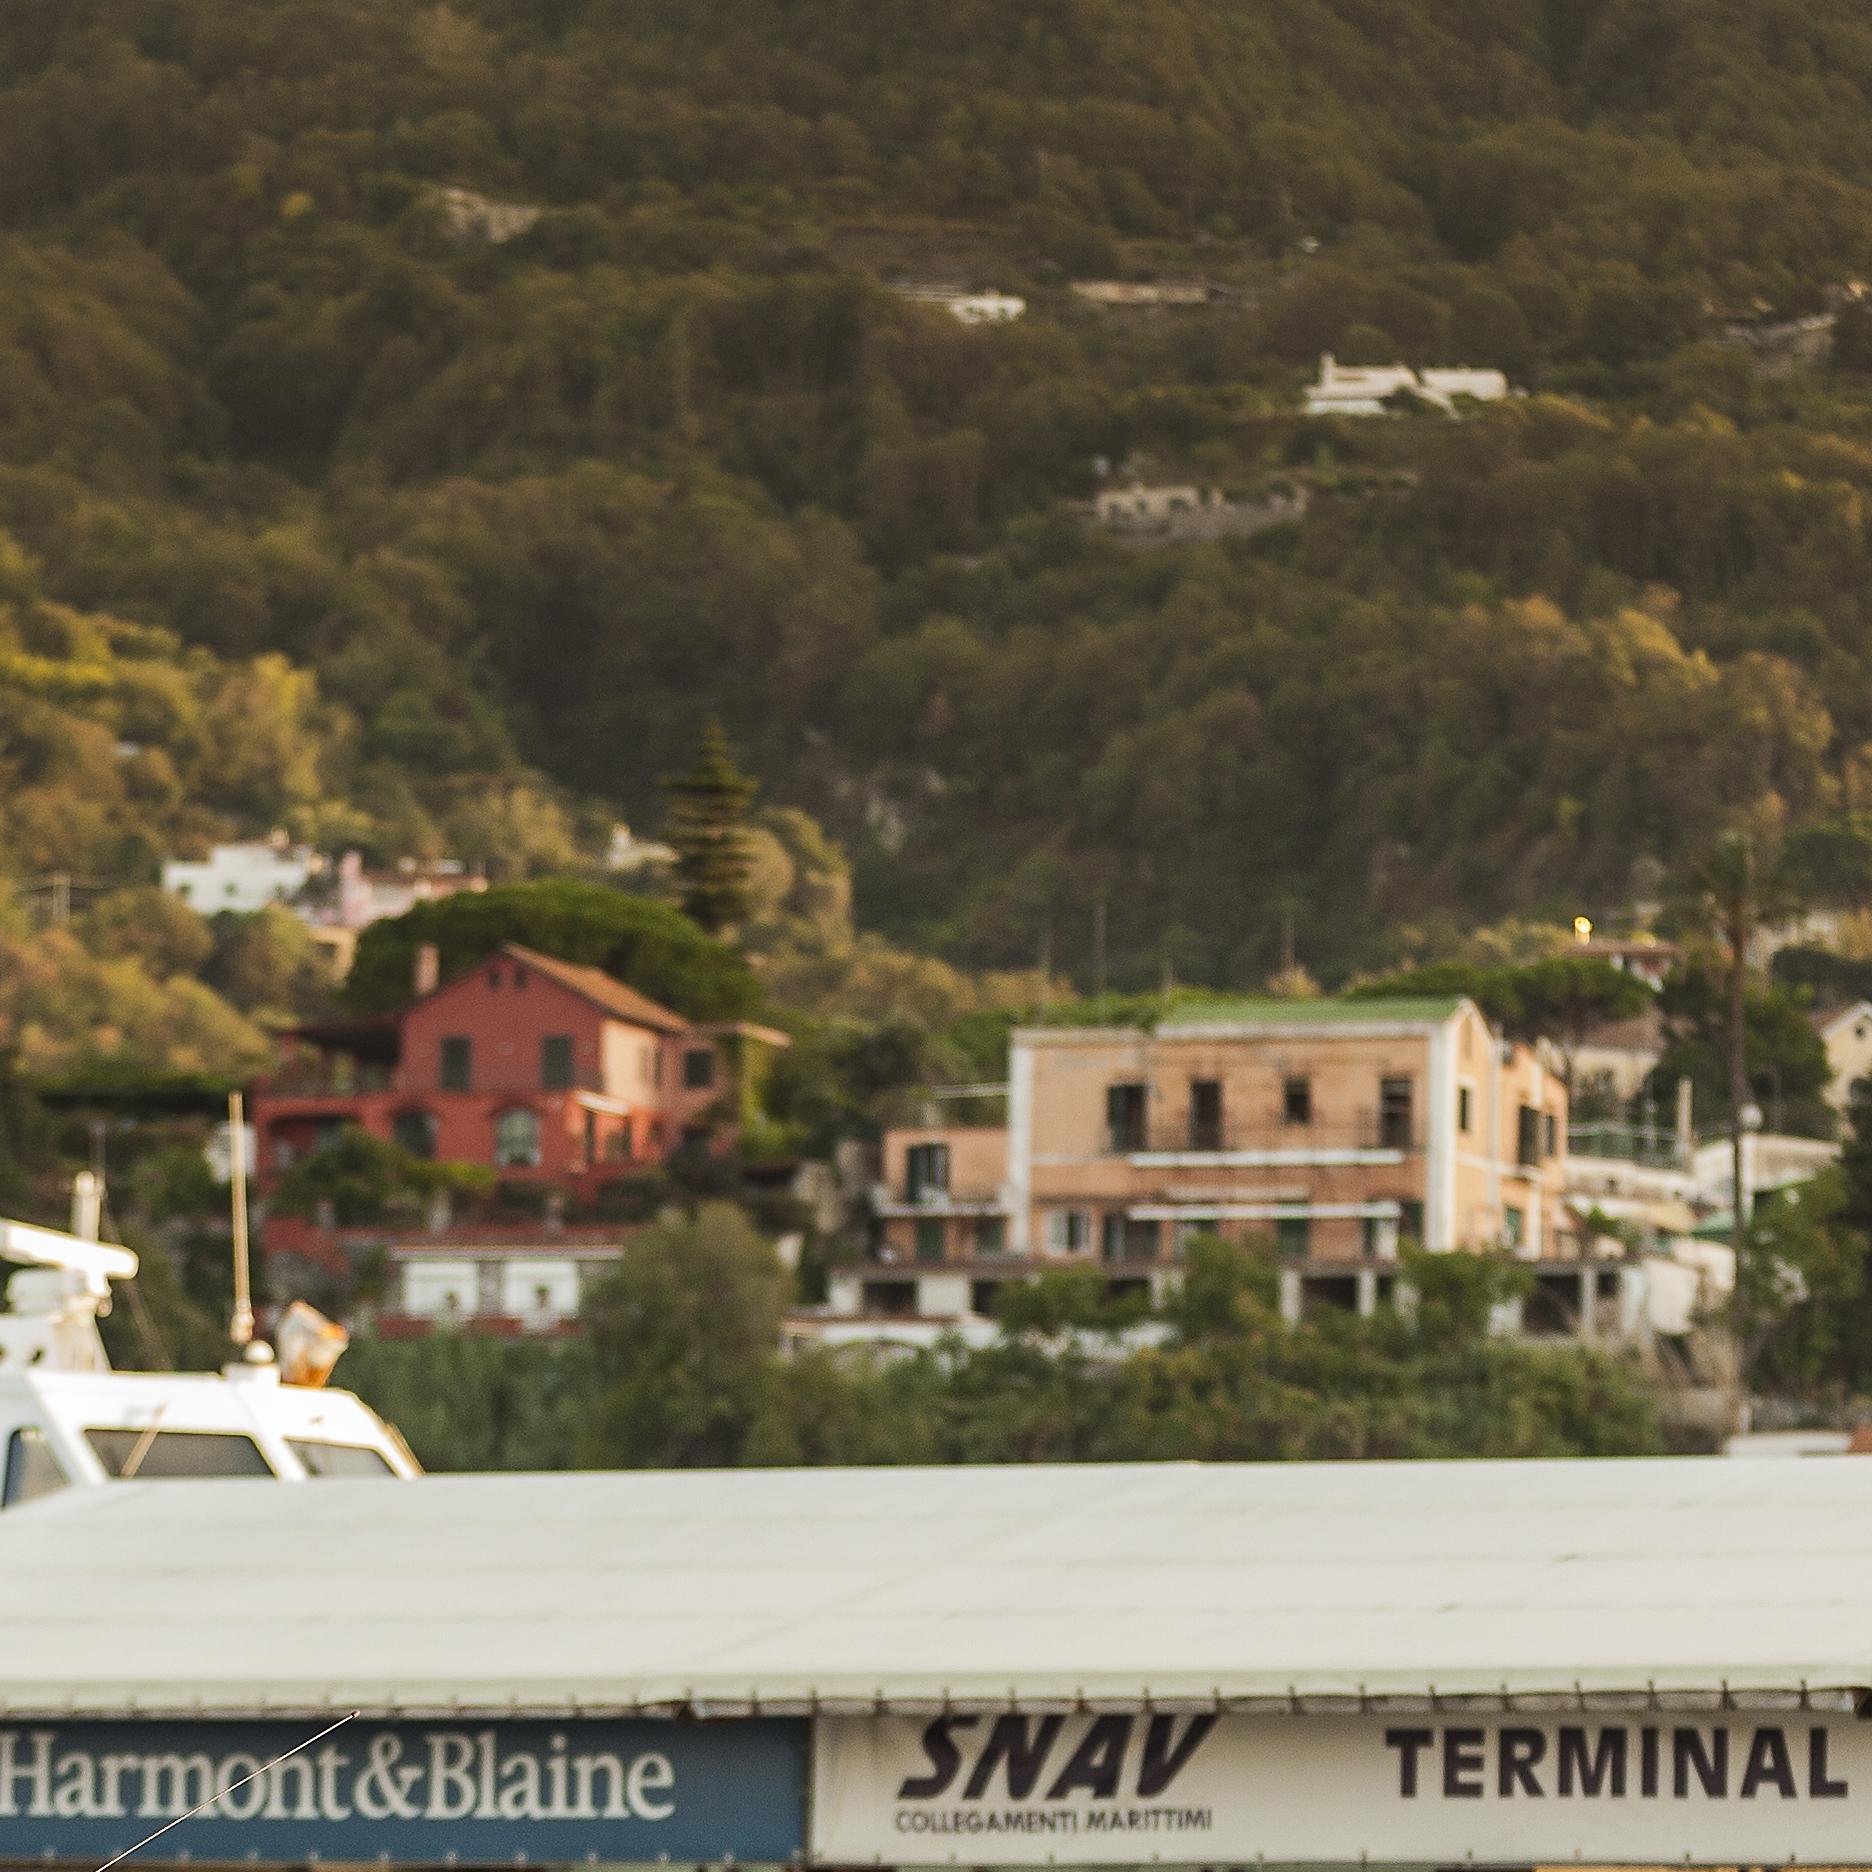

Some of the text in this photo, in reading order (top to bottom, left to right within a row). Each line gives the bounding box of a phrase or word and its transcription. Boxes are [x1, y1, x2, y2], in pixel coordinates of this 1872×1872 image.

[898, 1712, 1220, 1800] SNAV
[1384, 1726, 1849, 1799] TERMINAL
[895, 1807, 1213, 1834] COLLEGAMENTI MARITTIMI
